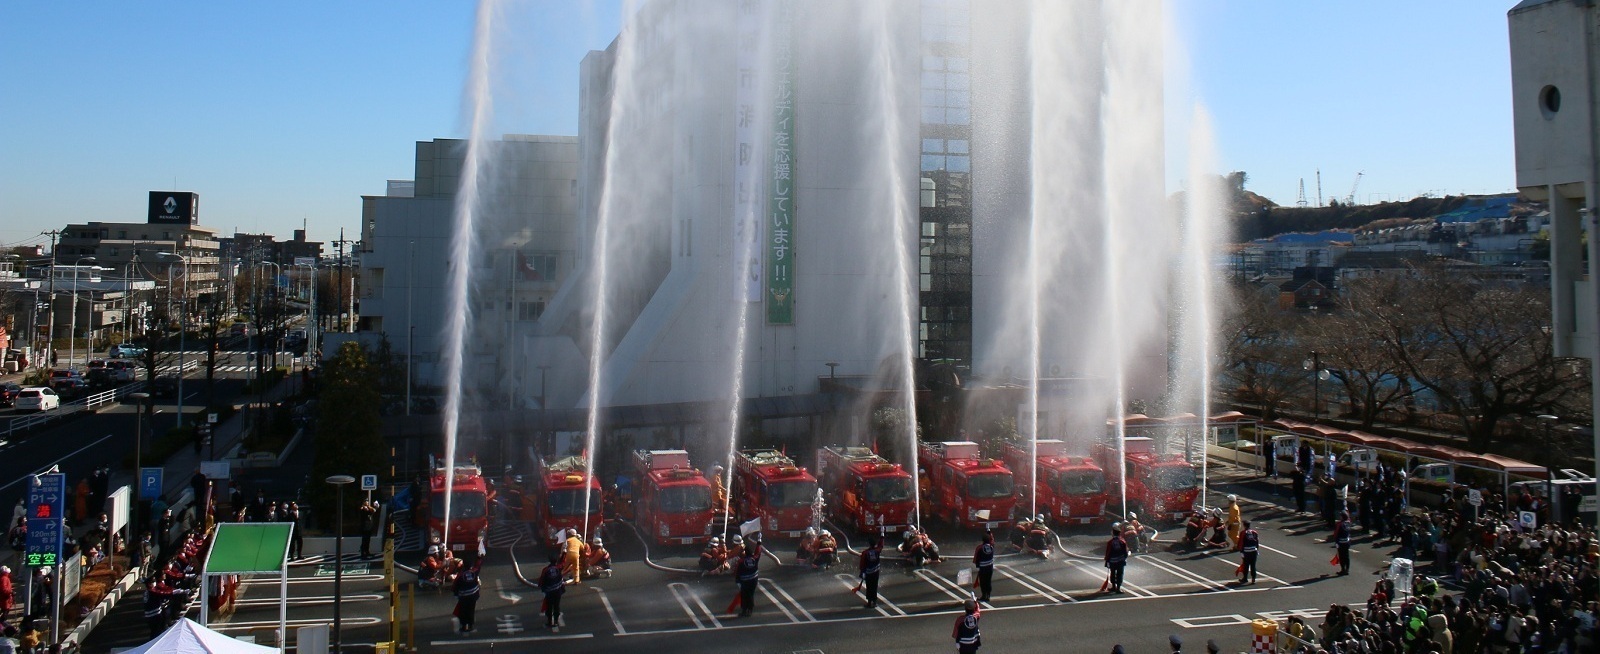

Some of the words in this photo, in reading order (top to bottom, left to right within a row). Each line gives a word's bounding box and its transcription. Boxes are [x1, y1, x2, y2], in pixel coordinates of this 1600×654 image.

[147, 476, 156, 487] P
[31, 494, 44, 504] P1
[37, 504, 51, 518] 満
[44, 544, 55, 552] P3
[28, 552, 41, 566] 空
[43, 552, 56, 566] 空
